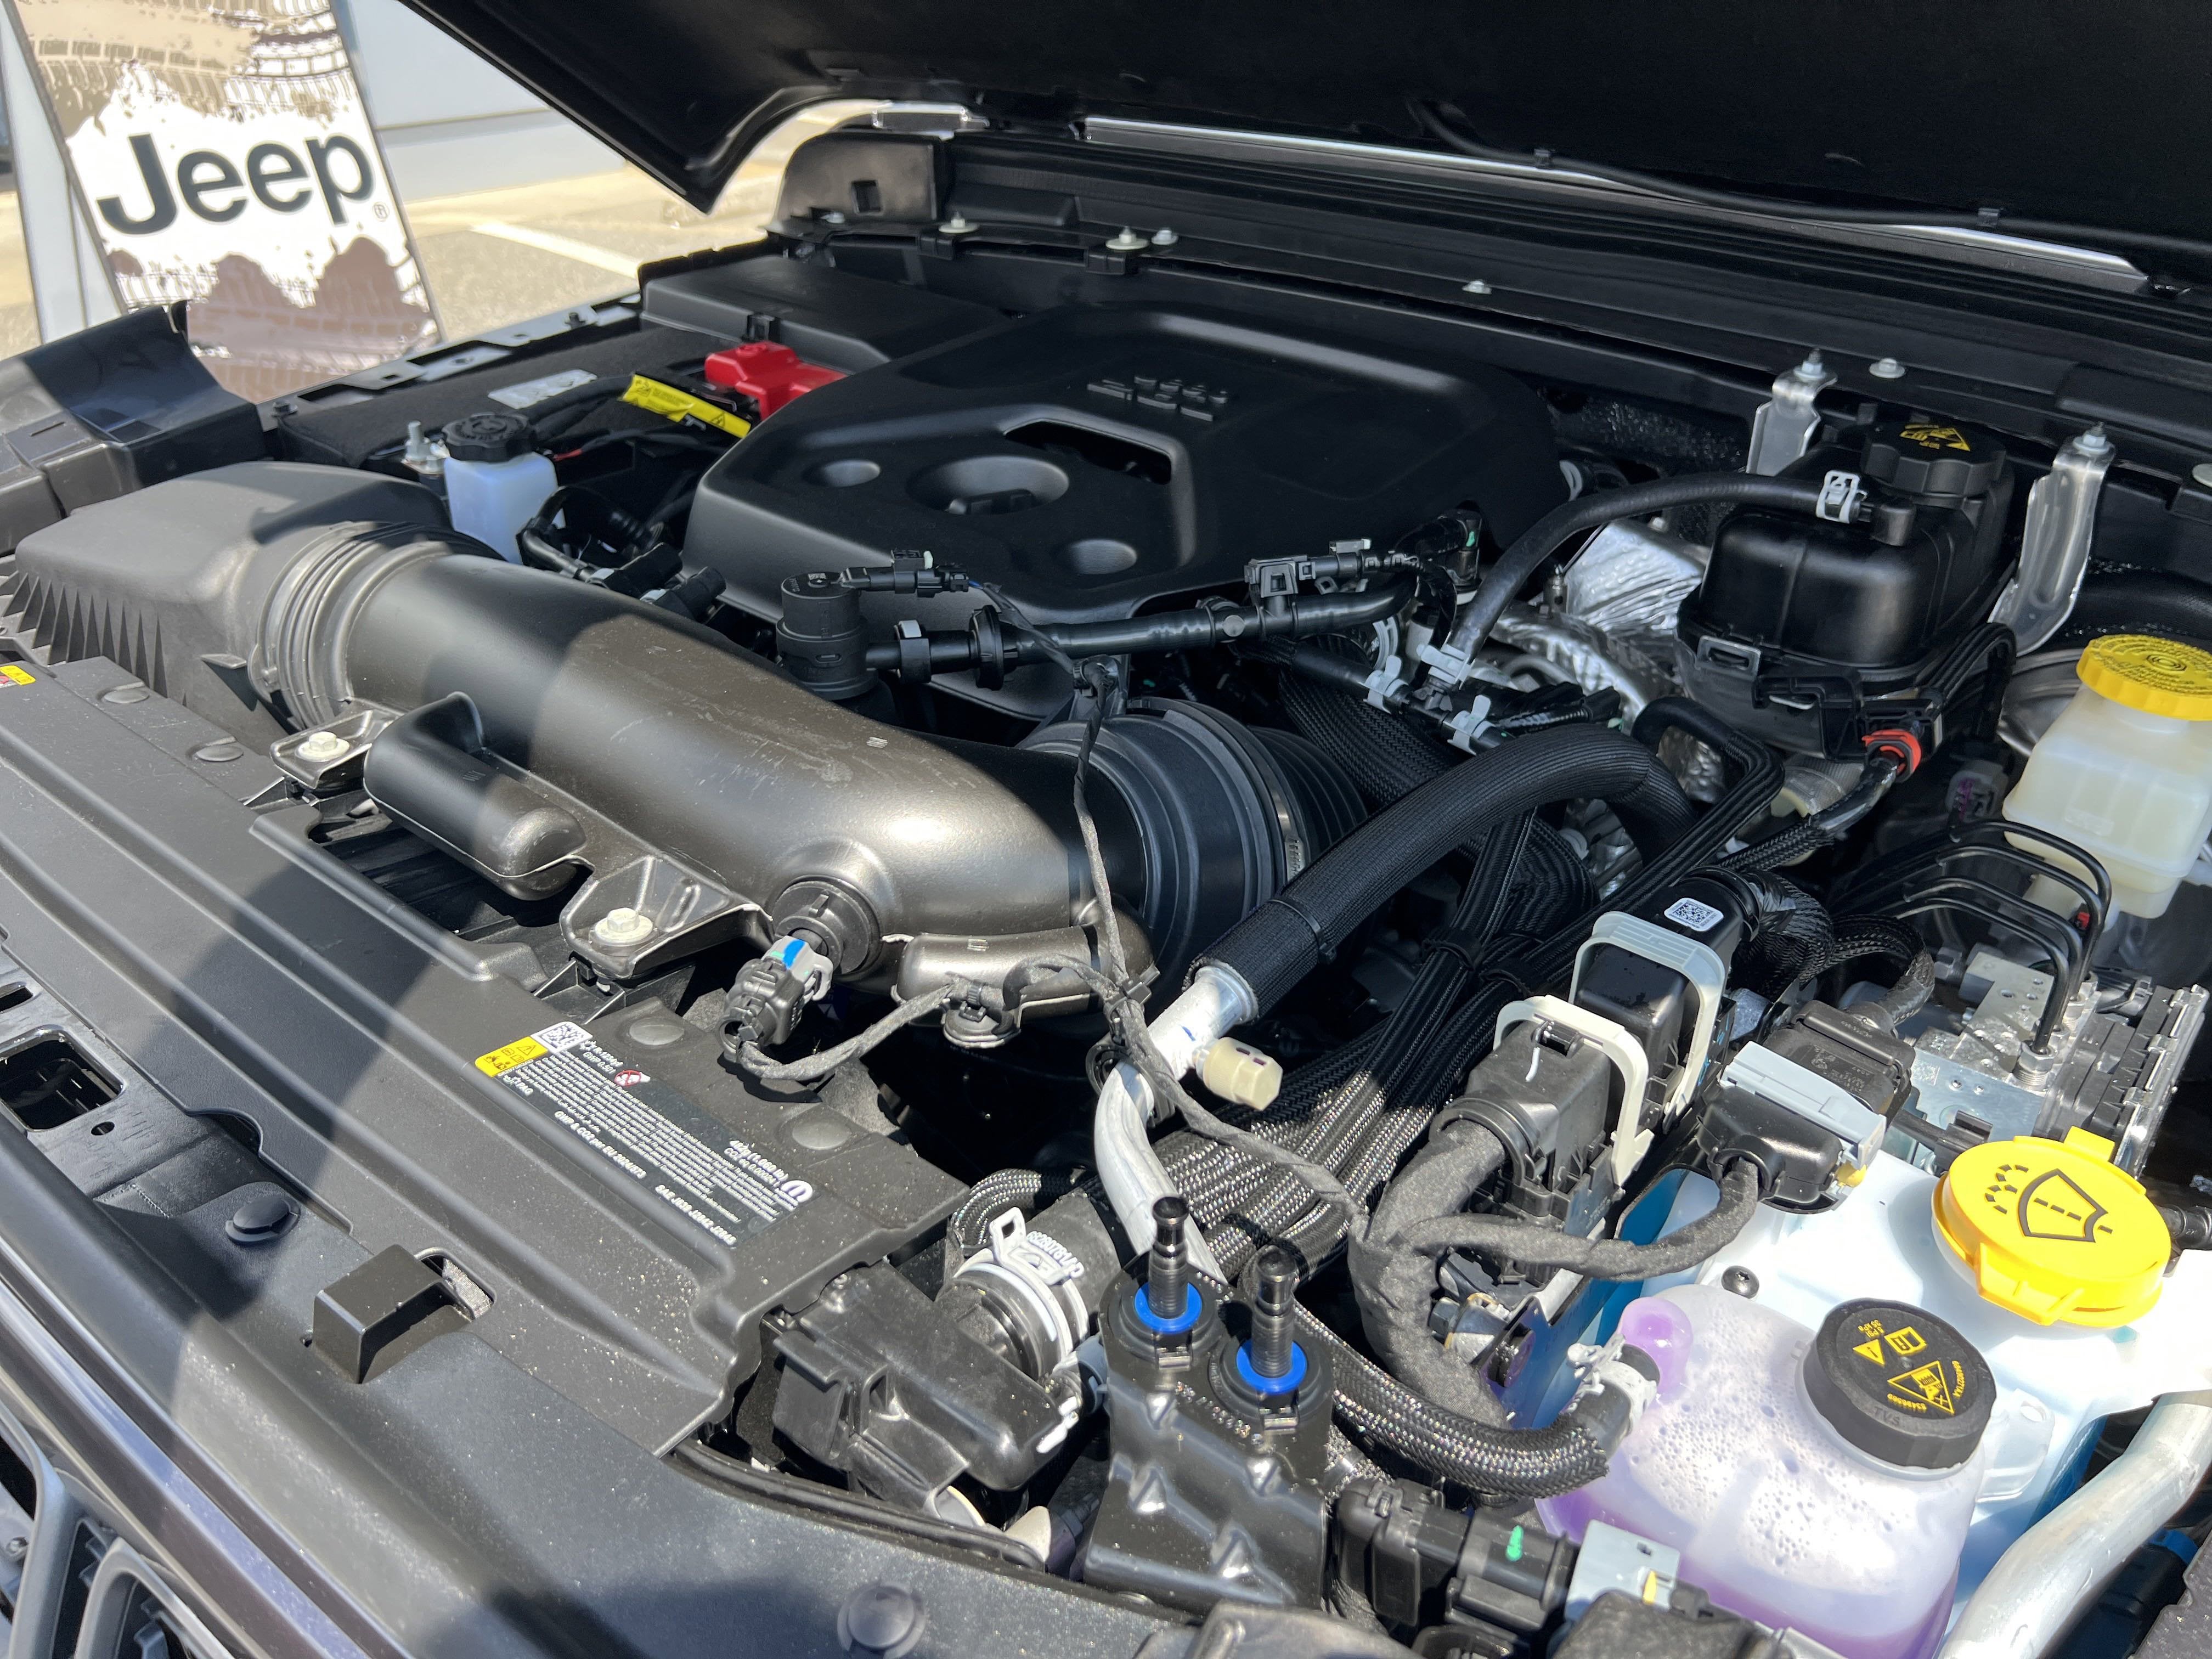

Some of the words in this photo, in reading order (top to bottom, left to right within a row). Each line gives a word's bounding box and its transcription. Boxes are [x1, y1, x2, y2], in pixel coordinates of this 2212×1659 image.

[96, 132, 374, 235] Jeep
[583, 1052, 601, 1063] GWP
[597, 1061, 617, 1074] 0.501
[515, 1079, 534, 1097] PAG
[554, 1110, 574, 1125] GWP
[570, 1122, 580, 1131] &
[576, 1127, 596, 1142] CO2
[589, 1138, 606, 1150] per
[602, 1146, 618, 1158] EU
[654, 1184, 676, 1200] SAE
[1866, 1328, 1880, 1339] PSI
